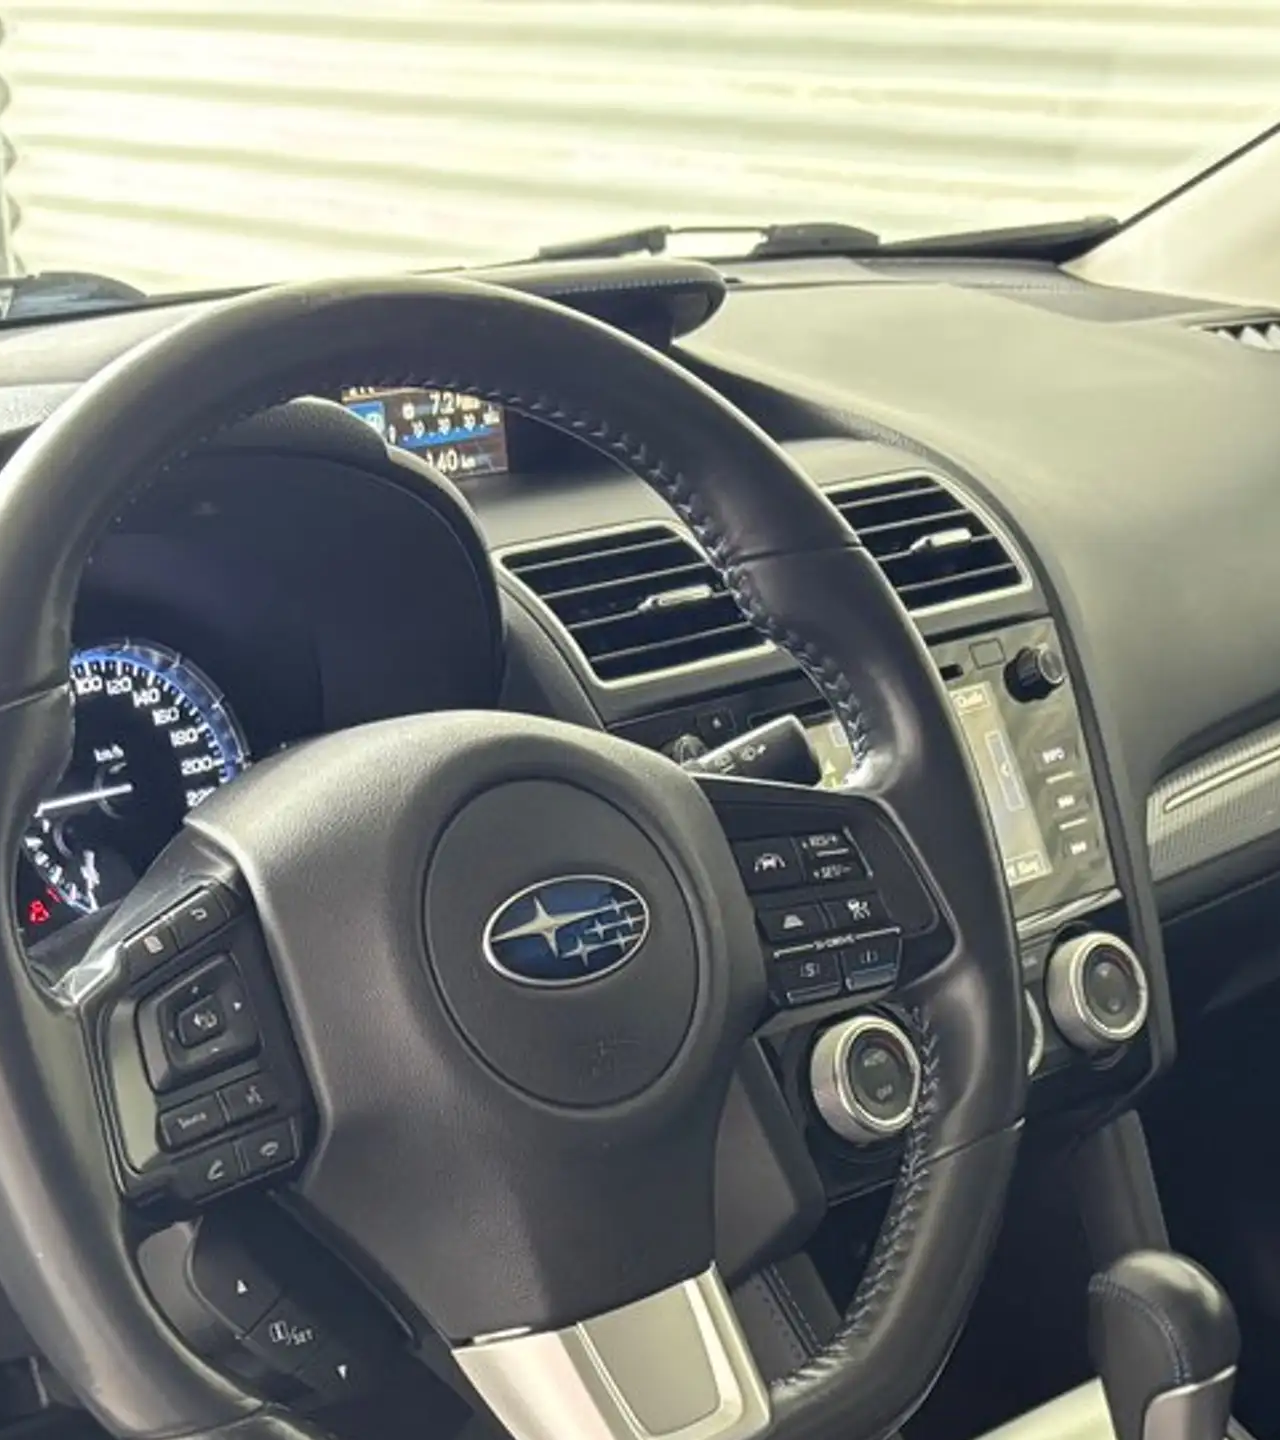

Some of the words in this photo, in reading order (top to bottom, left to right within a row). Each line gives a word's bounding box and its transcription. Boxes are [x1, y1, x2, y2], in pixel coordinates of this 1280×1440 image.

[75, 676, 103, 696] 100
[106, 676, 133, 696] 120
[132, 688, 161, 709] 140
[152, 706, 180, 726] 160
[170, 727, 199, 748] 180
[181, 755, 213, 777] 200
